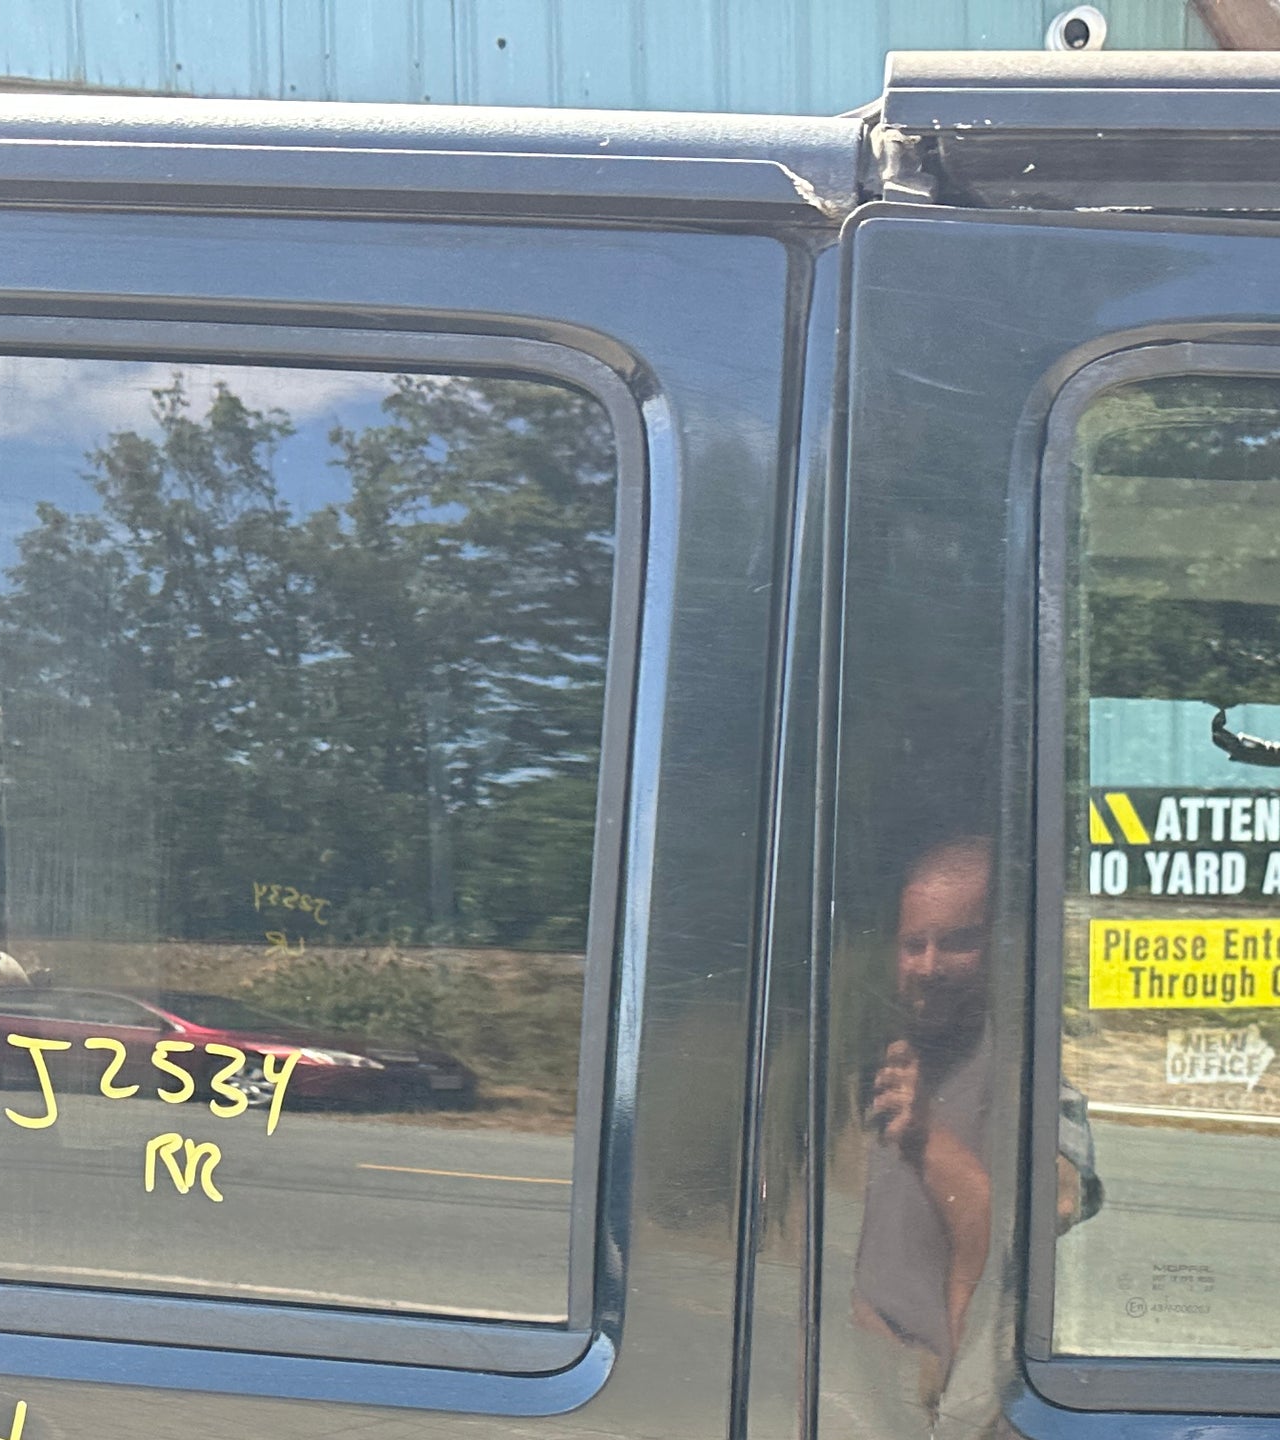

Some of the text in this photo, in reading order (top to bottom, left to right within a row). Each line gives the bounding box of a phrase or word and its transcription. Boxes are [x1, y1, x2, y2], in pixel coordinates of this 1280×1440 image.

[1145, 851, 1246, 895] YARD
[1102, 929, 1207, 962] Please
[1128, 965, 1256, 1002] Through
[1184, 1031, 1248, 1054] NEW
[6, 1034, 303, 1135] J2534
[1170, 1053, 1260, 1079] OFFICE
[145, 1132, 223, 1202] RR
